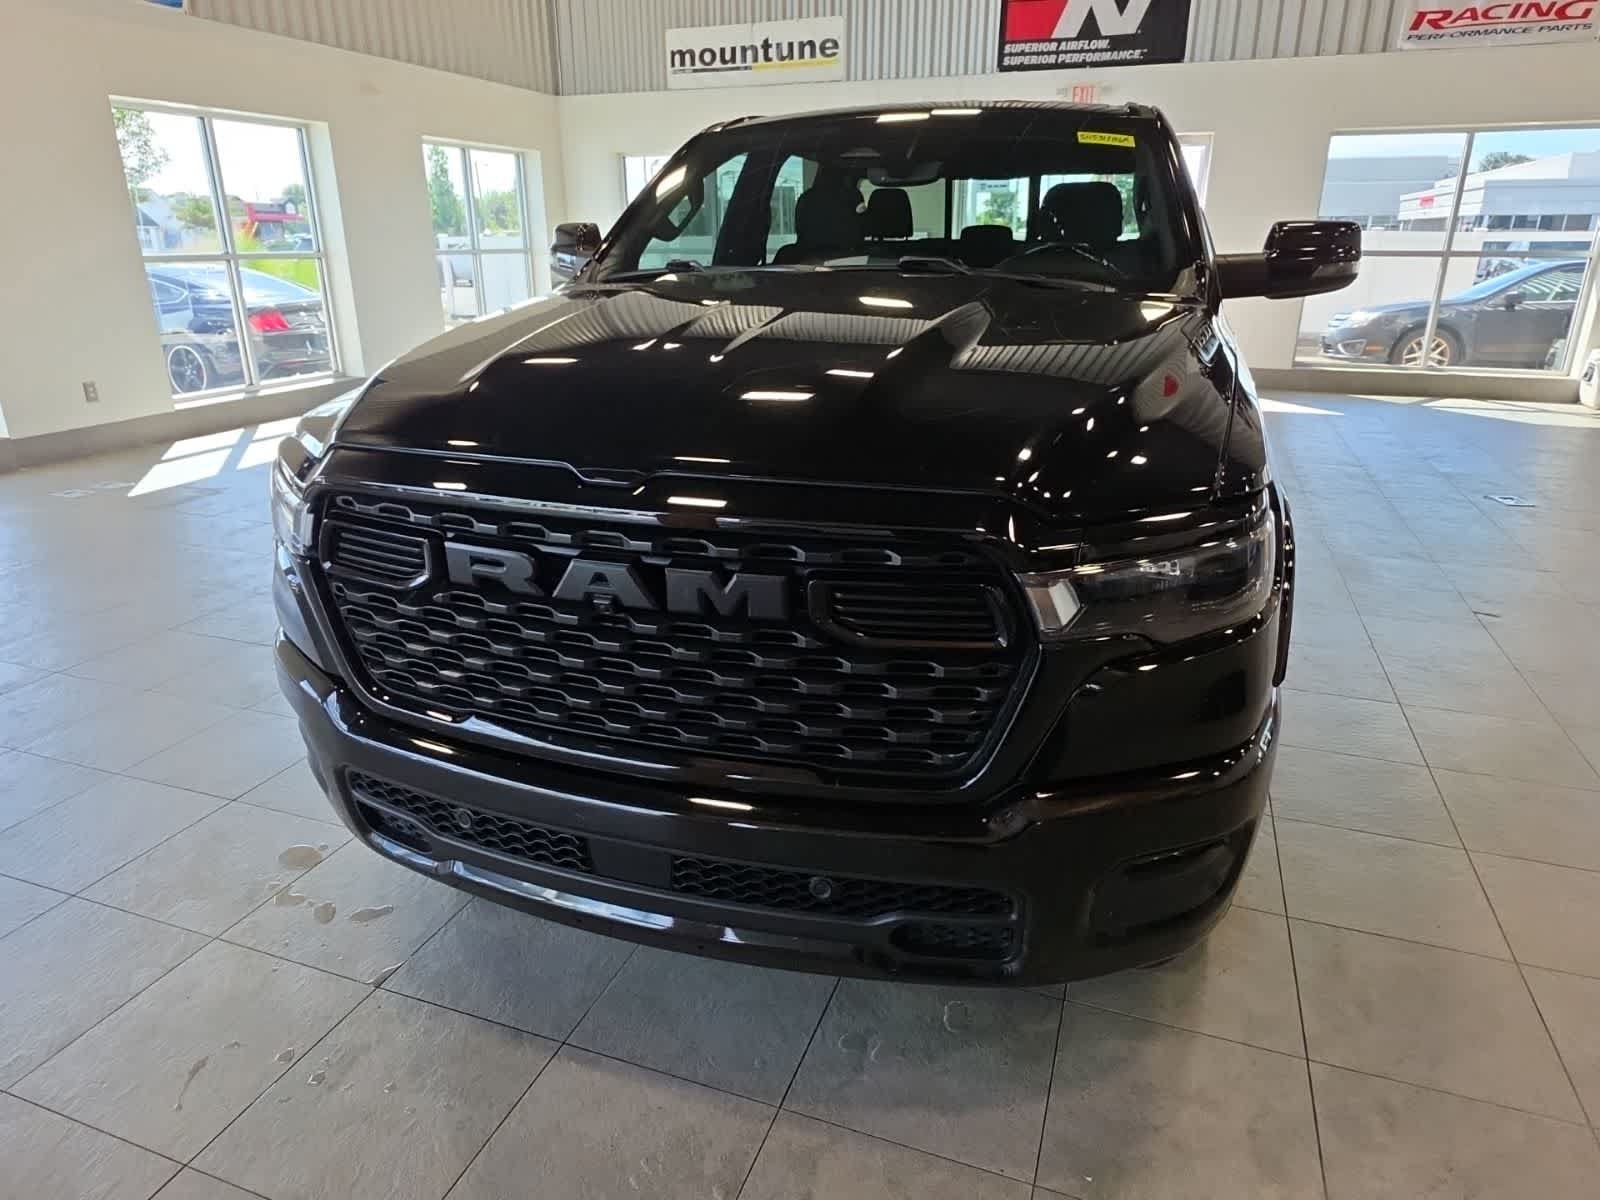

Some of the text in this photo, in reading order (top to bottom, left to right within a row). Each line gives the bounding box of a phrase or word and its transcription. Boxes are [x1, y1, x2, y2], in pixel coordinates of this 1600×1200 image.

[1409, 0, 1598, 31] RACING
[1406, 23, 1593, 41] PERFORMANCE PARTS
[670, 37, 839, 68] mountune
[1004, 39, 1111, 54] SUPERIOR AIRFLOW.
[1003, 53, 1058, 66] SUPERIOR
[444, 541, 788, 621] RAM
